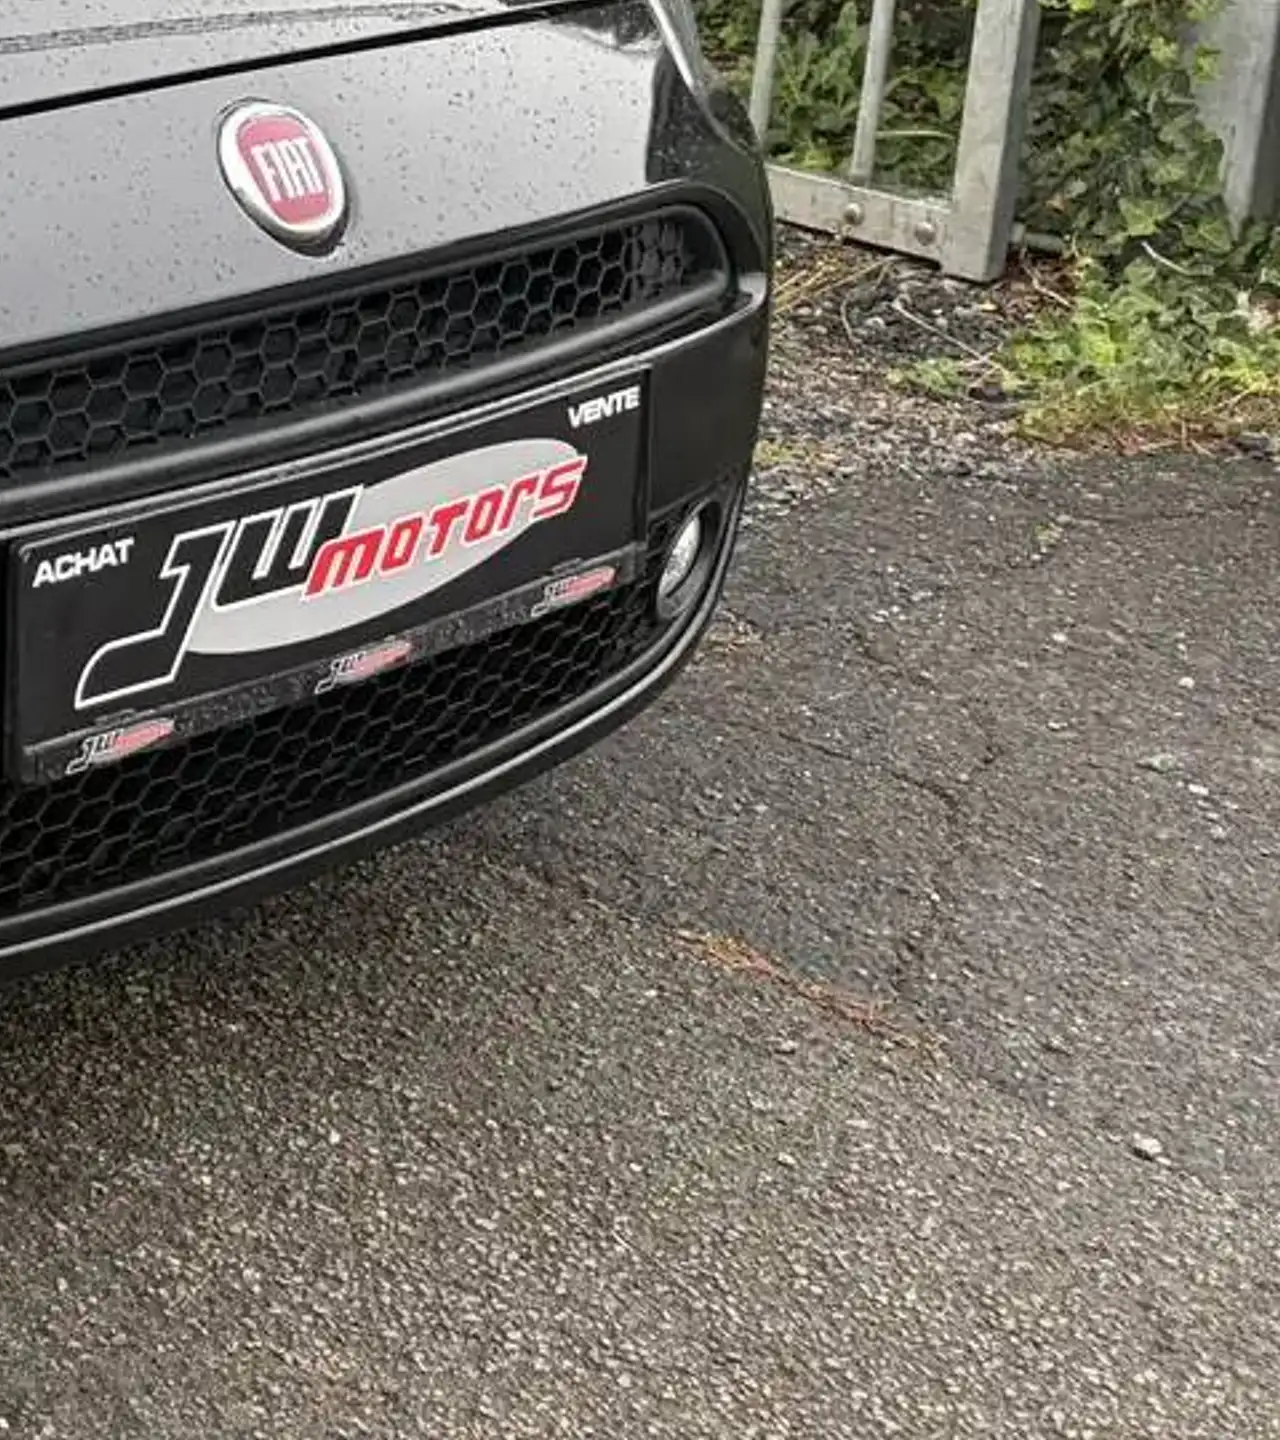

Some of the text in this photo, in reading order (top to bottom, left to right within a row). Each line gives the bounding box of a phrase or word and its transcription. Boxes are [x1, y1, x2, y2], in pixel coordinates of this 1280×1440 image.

[250, 135, 325, 202] FIAT
[566, 385, 640, 428] VENTE
[32, 537, 136, 588] ACHAT
